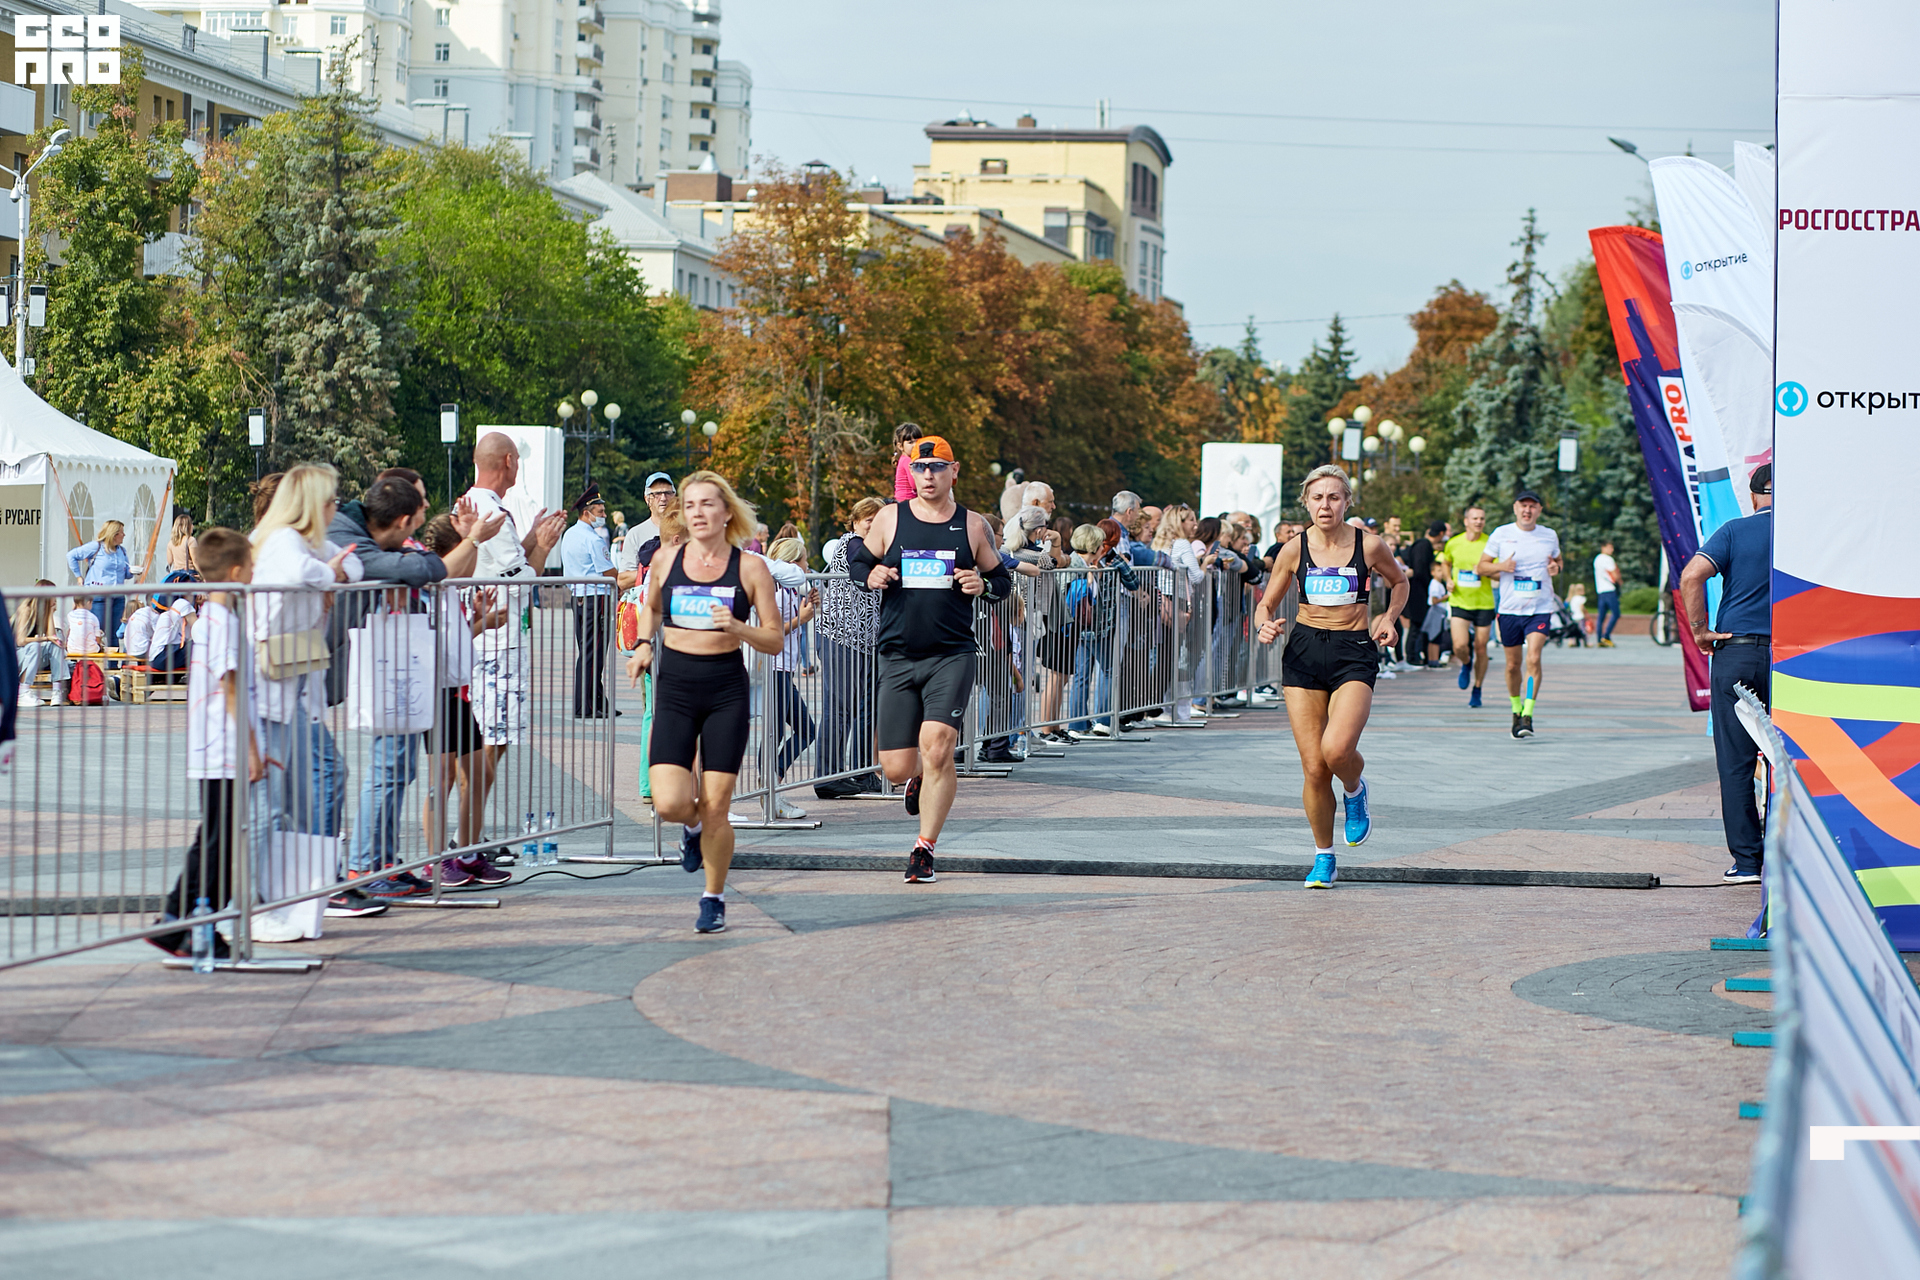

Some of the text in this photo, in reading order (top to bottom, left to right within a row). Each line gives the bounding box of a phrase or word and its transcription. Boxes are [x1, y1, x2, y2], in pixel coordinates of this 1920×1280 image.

[1779, 209, 1920, 231] РОСГОССТРА
[1695, 253, 1748, 272] открытие
[1816, 390, 1920, 415] открыт
[5, 509, 41, 525] РУСАГР
[909, 561, 942, 575] 1345
[1312, 579, 1342, 593] 1183
